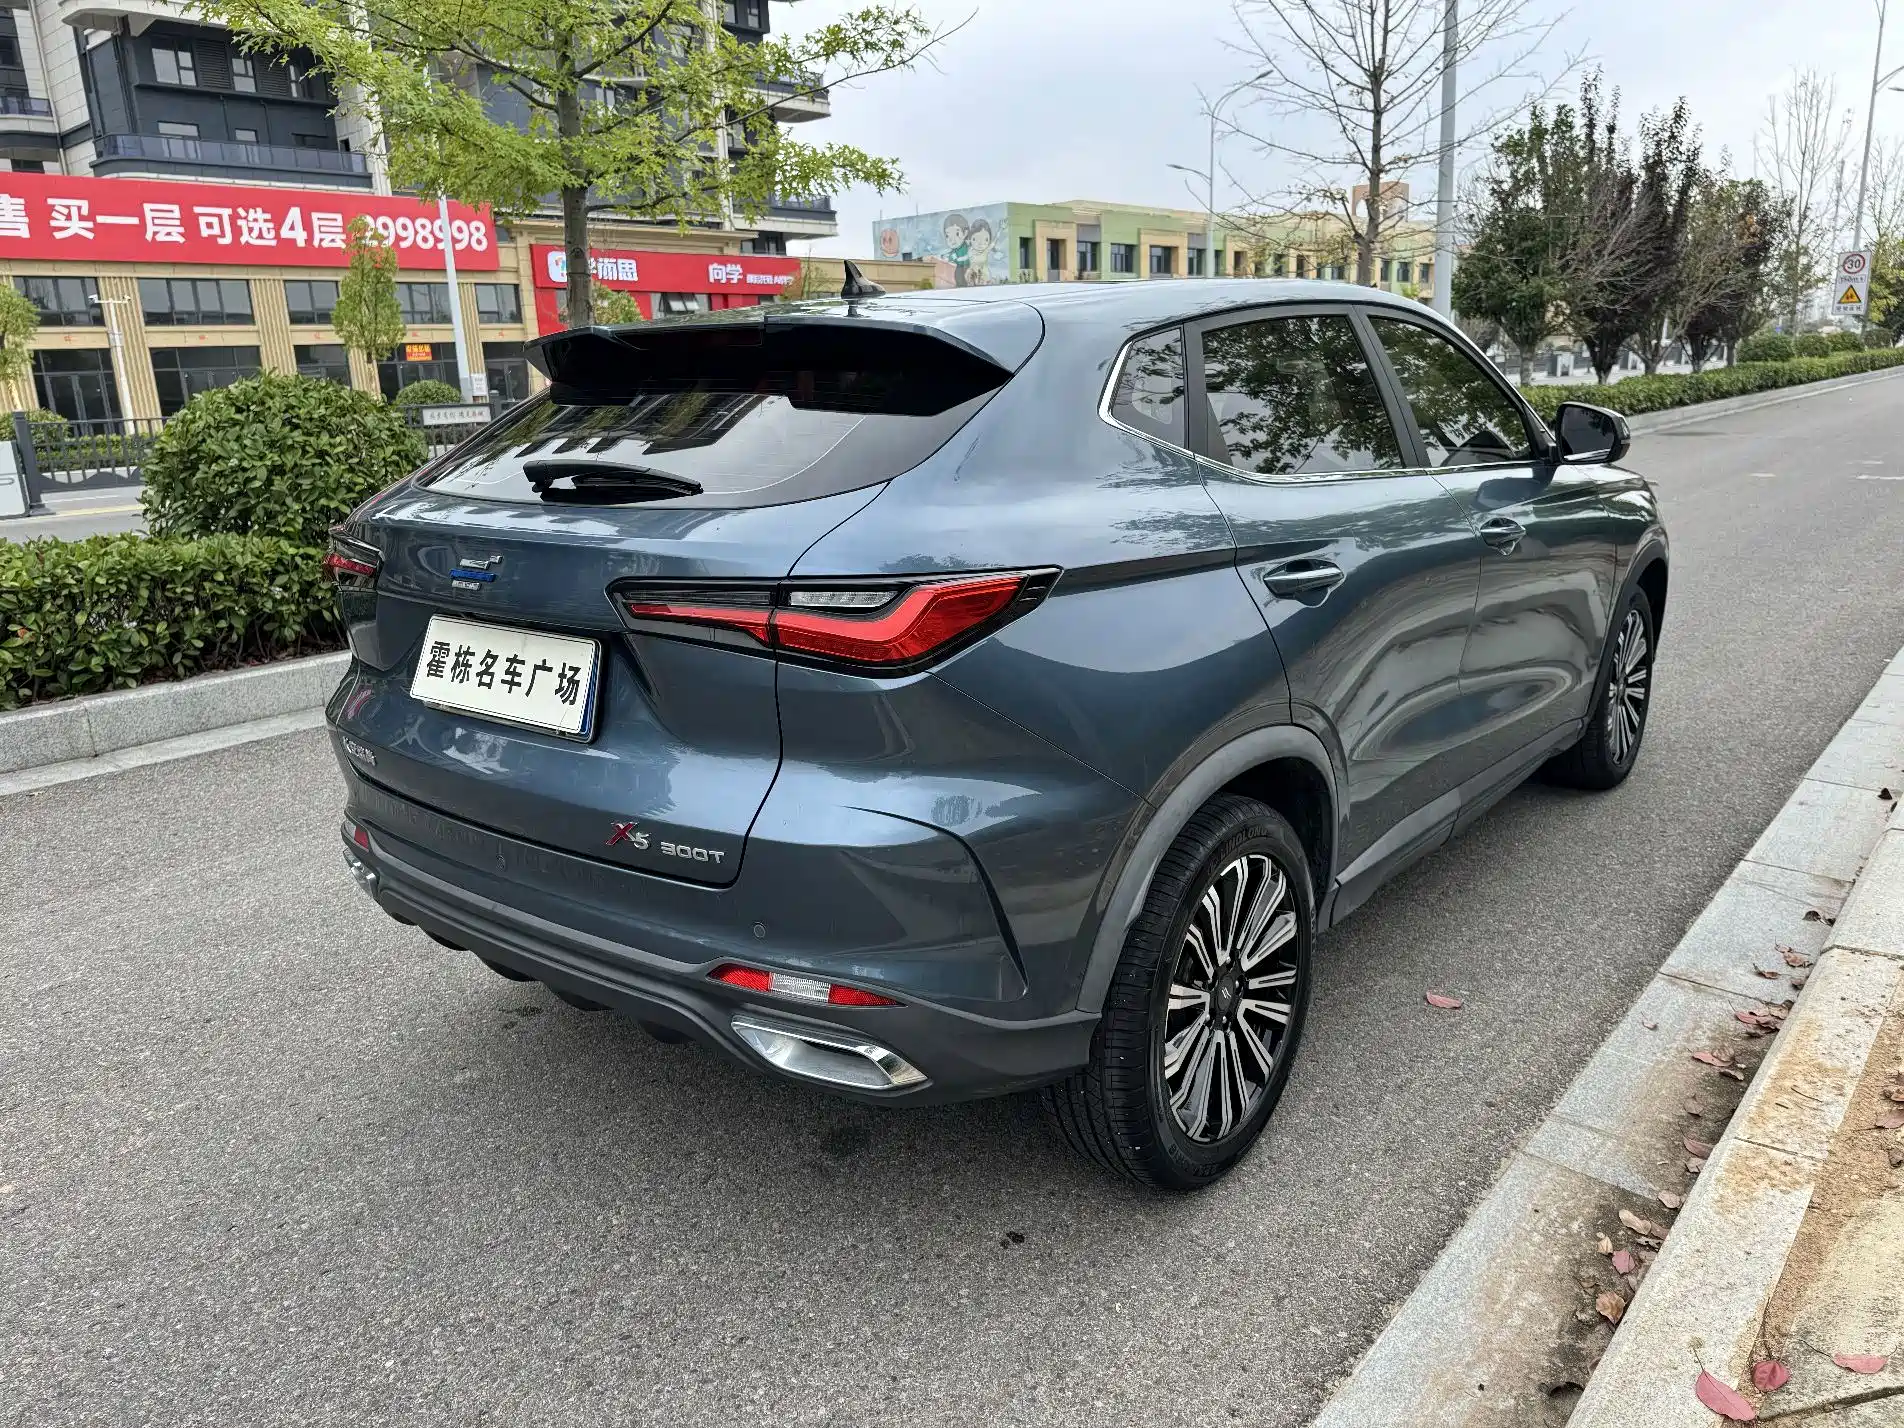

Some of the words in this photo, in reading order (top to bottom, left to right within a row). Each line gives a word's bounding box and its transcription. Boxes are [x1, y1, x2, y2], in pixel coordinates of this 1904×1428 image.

[47, 197, 185, 243] 买一层
[193, 205, 347, 249] 可选4层
[1847, 258, 1861, 270] 30
[426, 640, 582, 706] 霍栋名车广场
[660, 841, 725, 864] 300T
